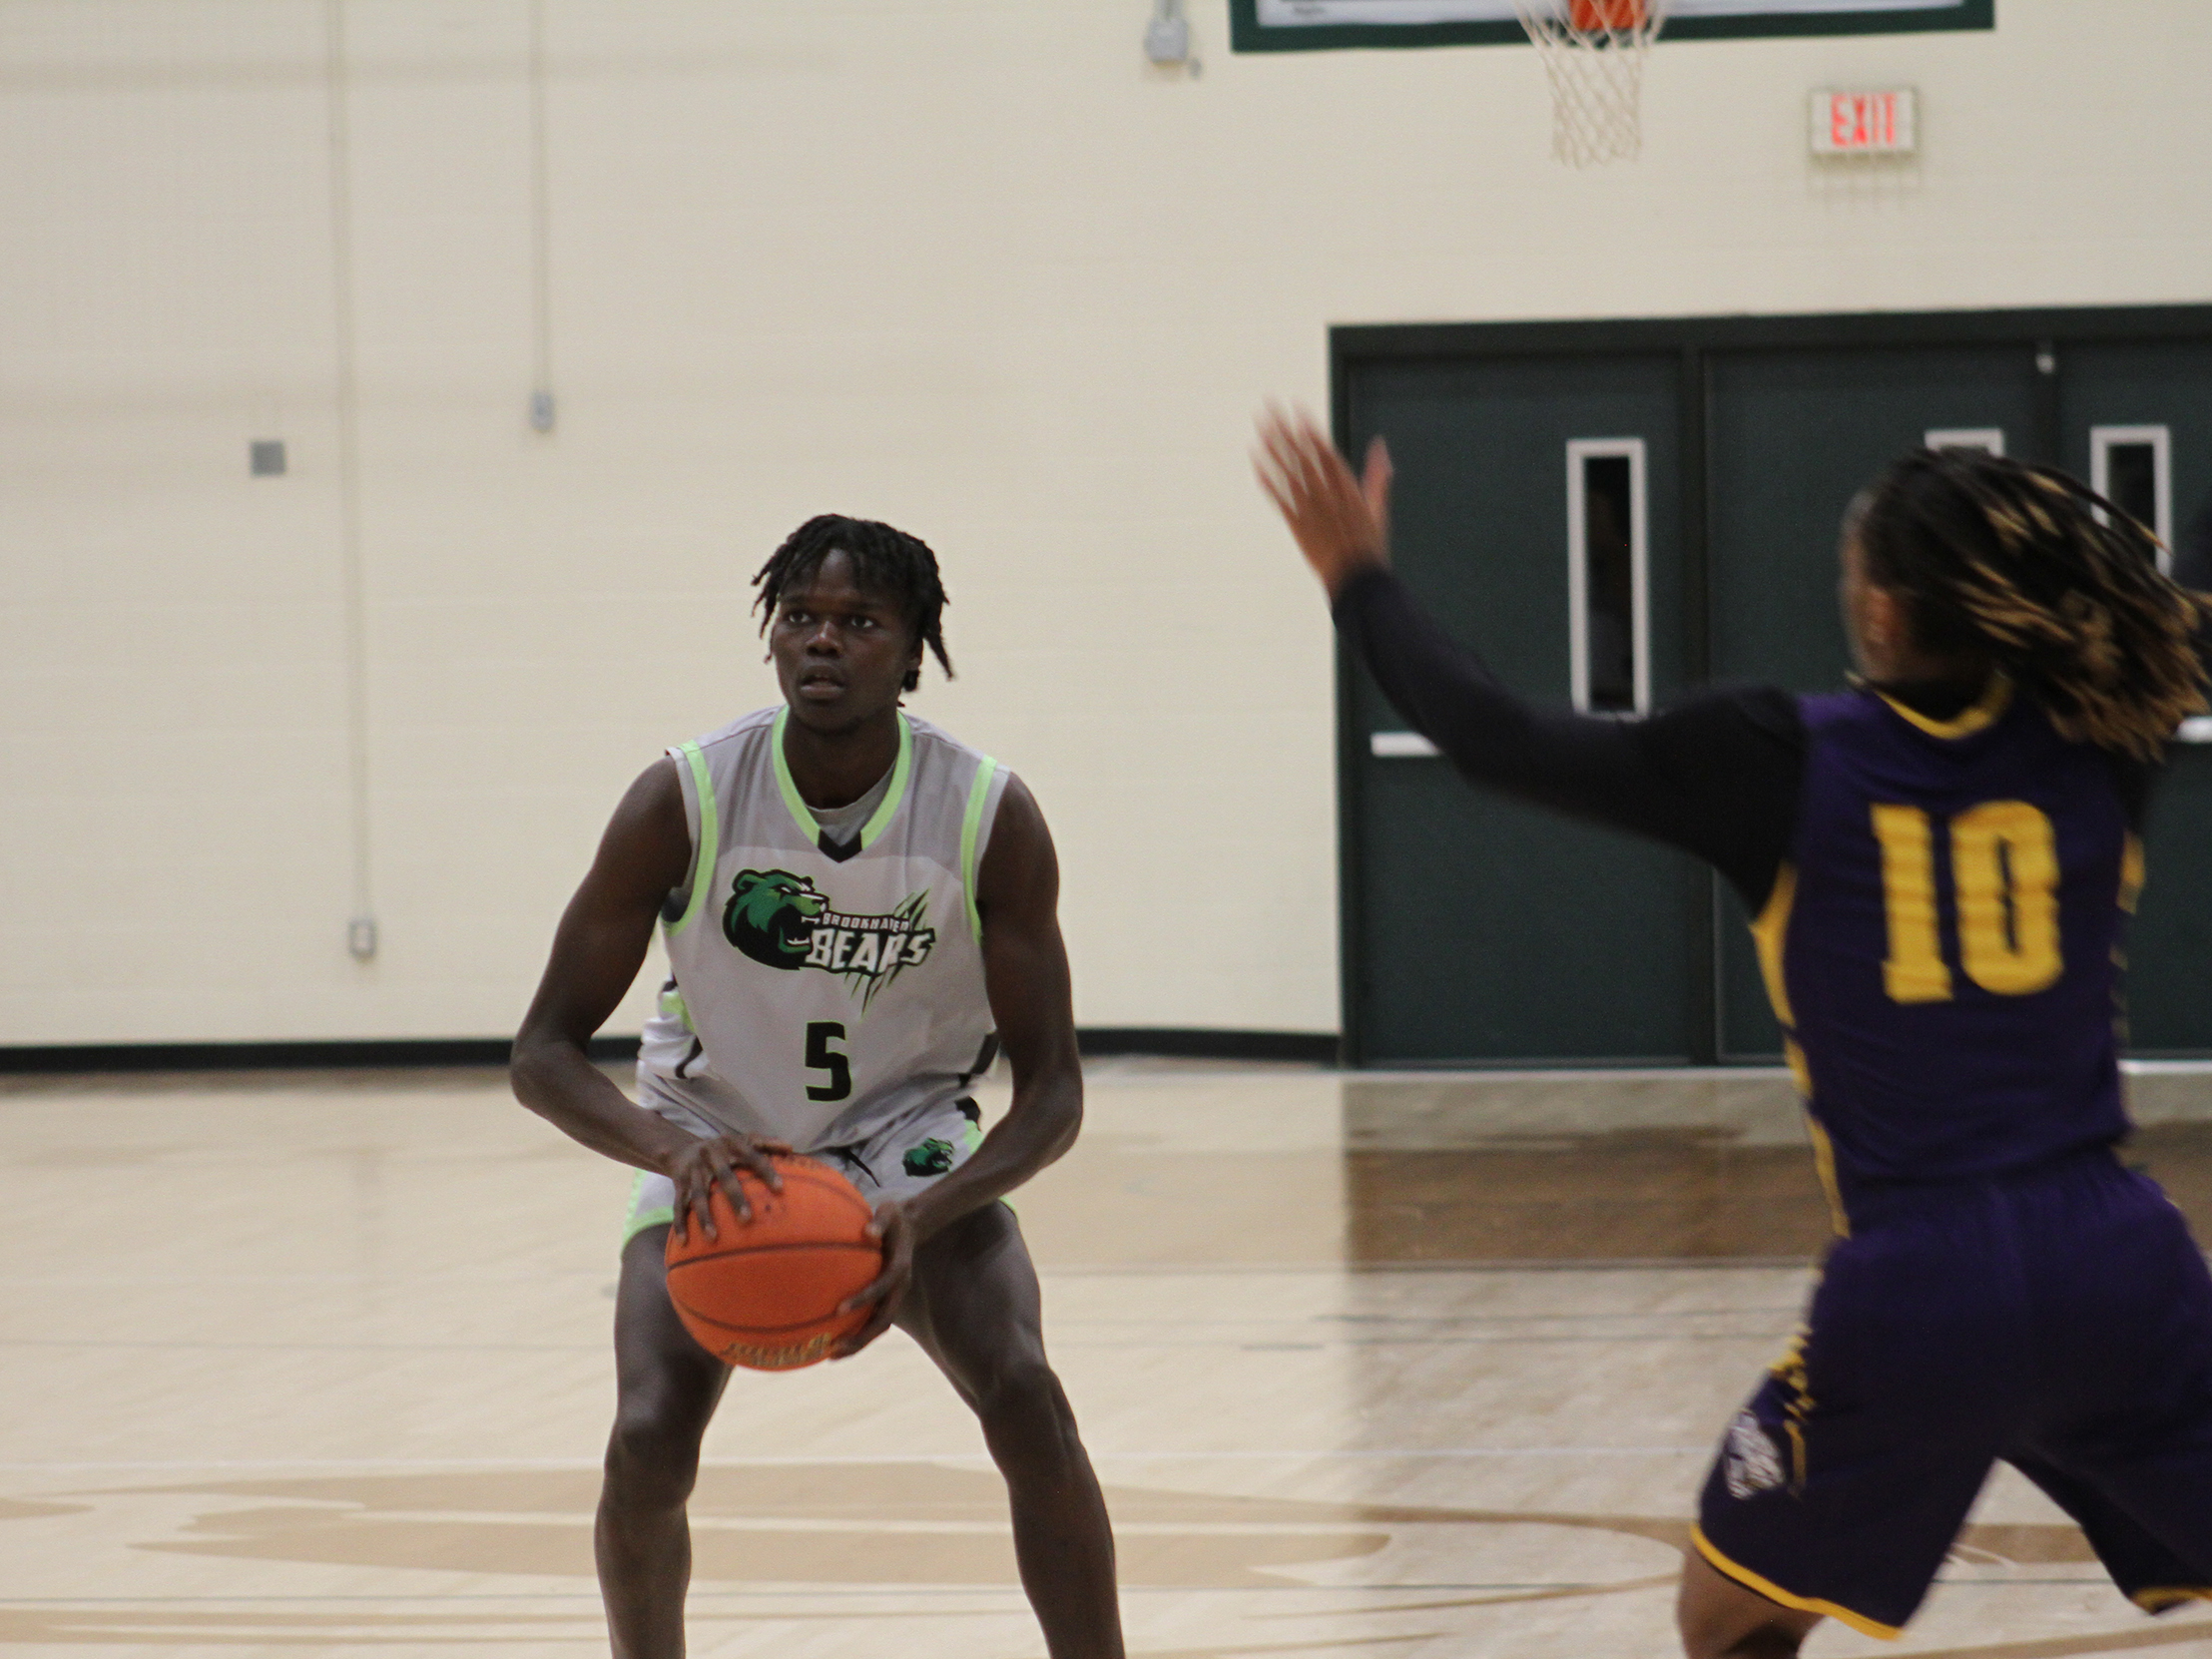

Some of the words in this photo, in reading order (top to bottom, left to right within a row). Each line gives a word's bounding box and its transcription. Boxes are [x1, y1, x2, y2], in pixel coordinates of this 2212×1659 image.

[1830, 92, 1897, 147] EXIT
[1870, 800, 2065, 1004] 10
[804, 927, 932, 975] BEARS
[805, 1020, 851, 1102] 5
